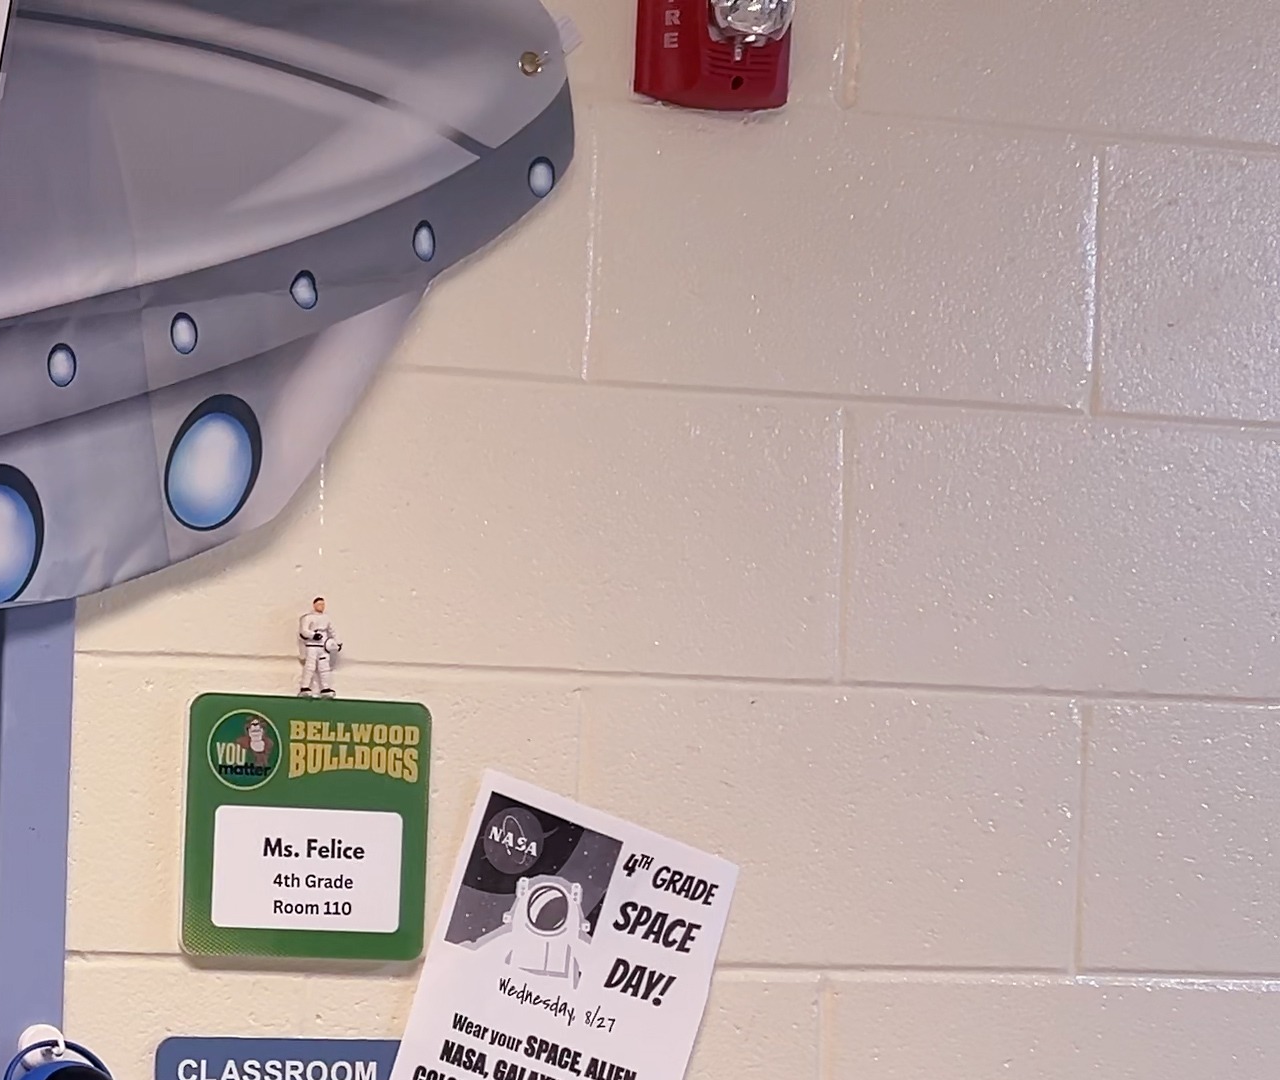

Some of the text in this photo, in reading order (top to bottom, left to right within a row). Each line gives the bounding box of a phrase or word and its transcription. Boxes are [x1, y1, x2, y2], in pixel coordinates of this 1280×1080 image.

[290, 720, 420, 745] BELLWOOD
[216, 741, 247, 766] YOU
[218, 762, 272, 777] matter
[288, 742, 420, 783] BULLDOGS
[263, 837, 365, 859] Ms. Felice
[489, 827, 538, 857] NASA
[273, 873, 354, 889] 4th Grade
[652, 866, 719, 905] GRADE
[273, 900, 352, 916] Room 110
[613, 902, 702, 953] SPACE
[604, 958, 677, 1006] DAY!
[499, 978, 616, 1032] Wednesday, 8/27
[439, 1039, 489, 1079] NASA,
[452, 1013, 489, 1041] Wear
[489, 1028, 523, 1053] your
[524, 1035, 582, 1077] SPACE,
